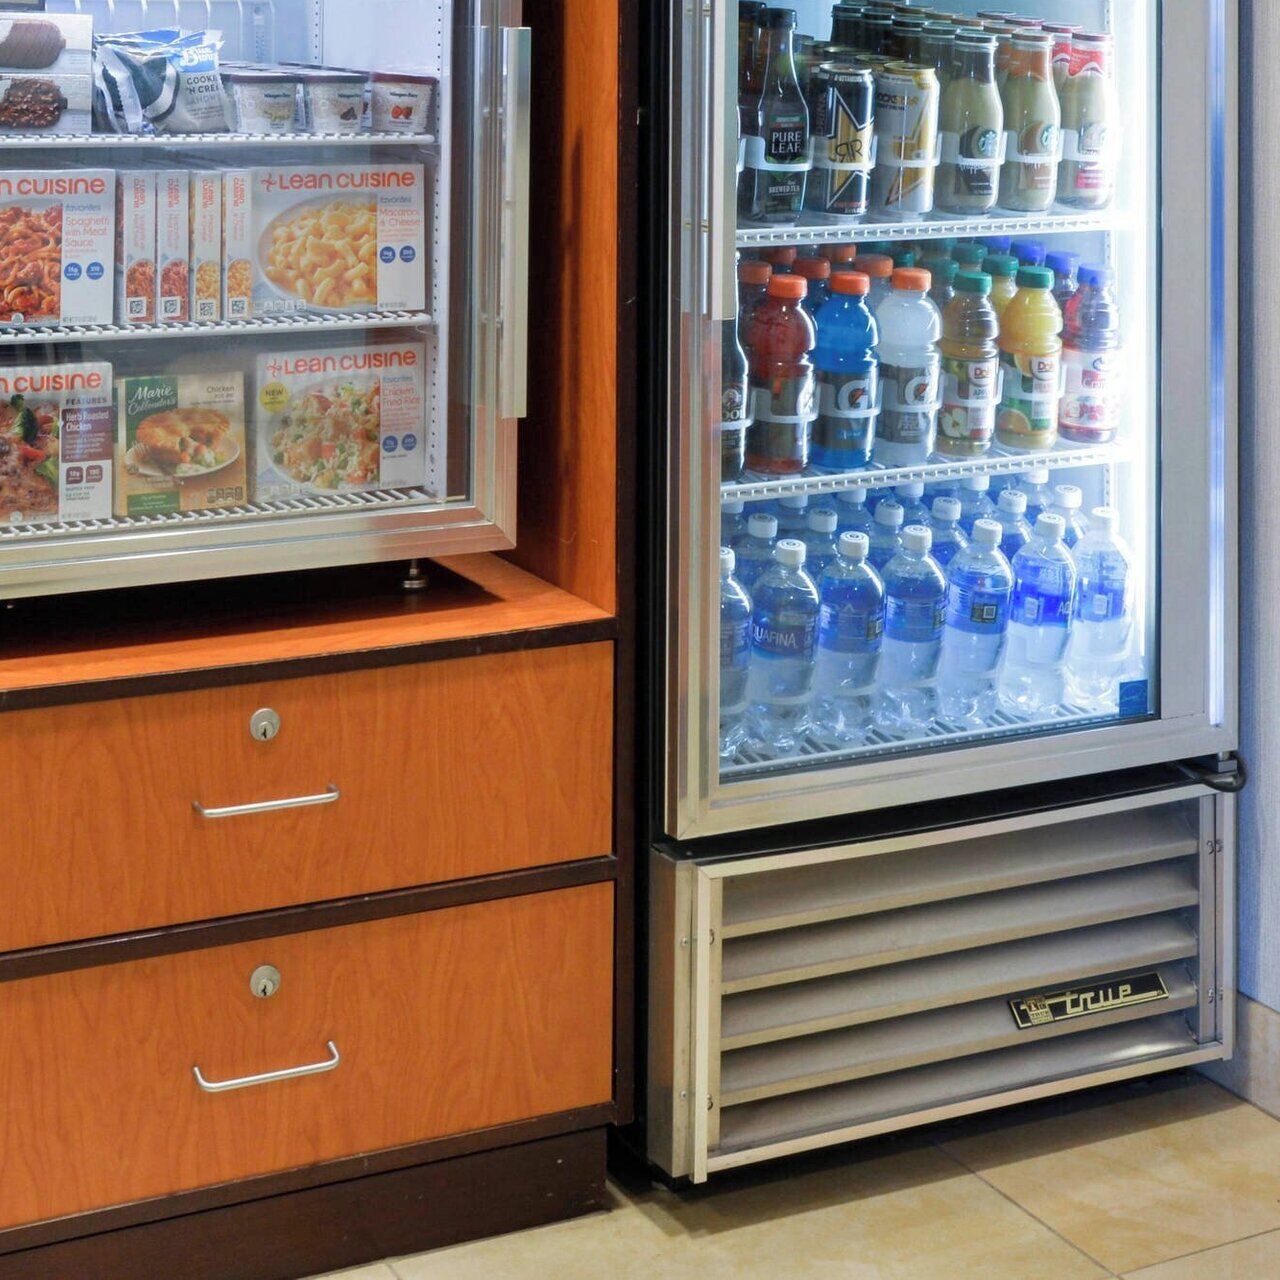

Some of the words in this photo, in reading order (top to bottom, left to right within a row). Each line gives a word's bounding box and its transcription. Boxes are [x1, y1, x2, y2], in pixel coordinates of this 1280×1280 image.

[772, 131, 801, 142] PURE
[772, 142, 801, 154] LEAF
[17, 177, 105, 195] cuisine
[279, 173, 332, 190] Lean
[336, 171, 416, 189] cuisine
[285, 357, 336, 374] Lean
[340, 349, 416, 370] cuisine
[14, 371, 101, 393] cuisine
[66, 397, 107, 405] FEATURES
[129, 385, 173, 403] Marie
